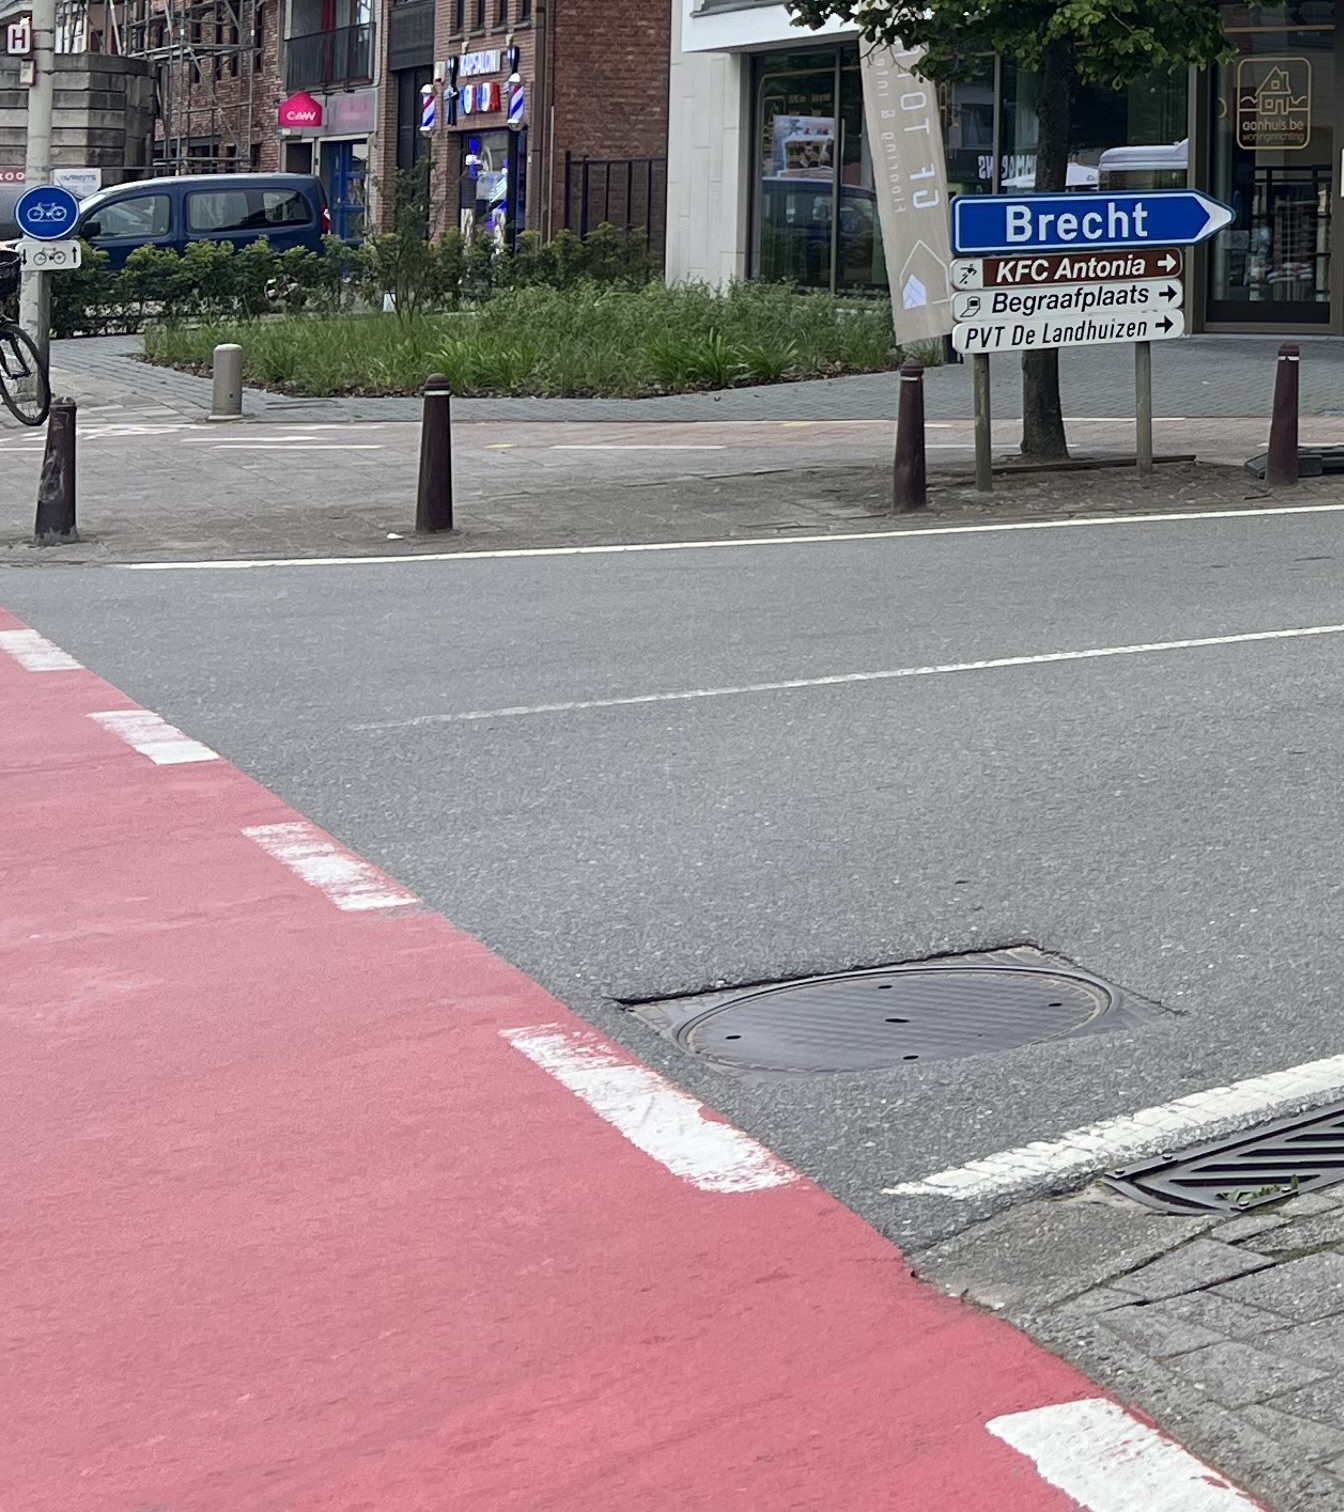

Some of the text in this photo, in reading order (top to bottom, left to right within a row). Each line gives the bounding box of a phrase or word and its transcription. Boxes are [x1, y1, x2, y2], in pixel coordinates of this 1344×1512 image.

[1242, 117, 1305, 131] aanhuis.be
[1006, 202, 1148, 243] Brecht
[996, 254, 1146, 283] KFC Antonia
[992, 286, 1149, 316] Begraafplaats
[965, 319, 1148, 349] PVT De Landhuizen
